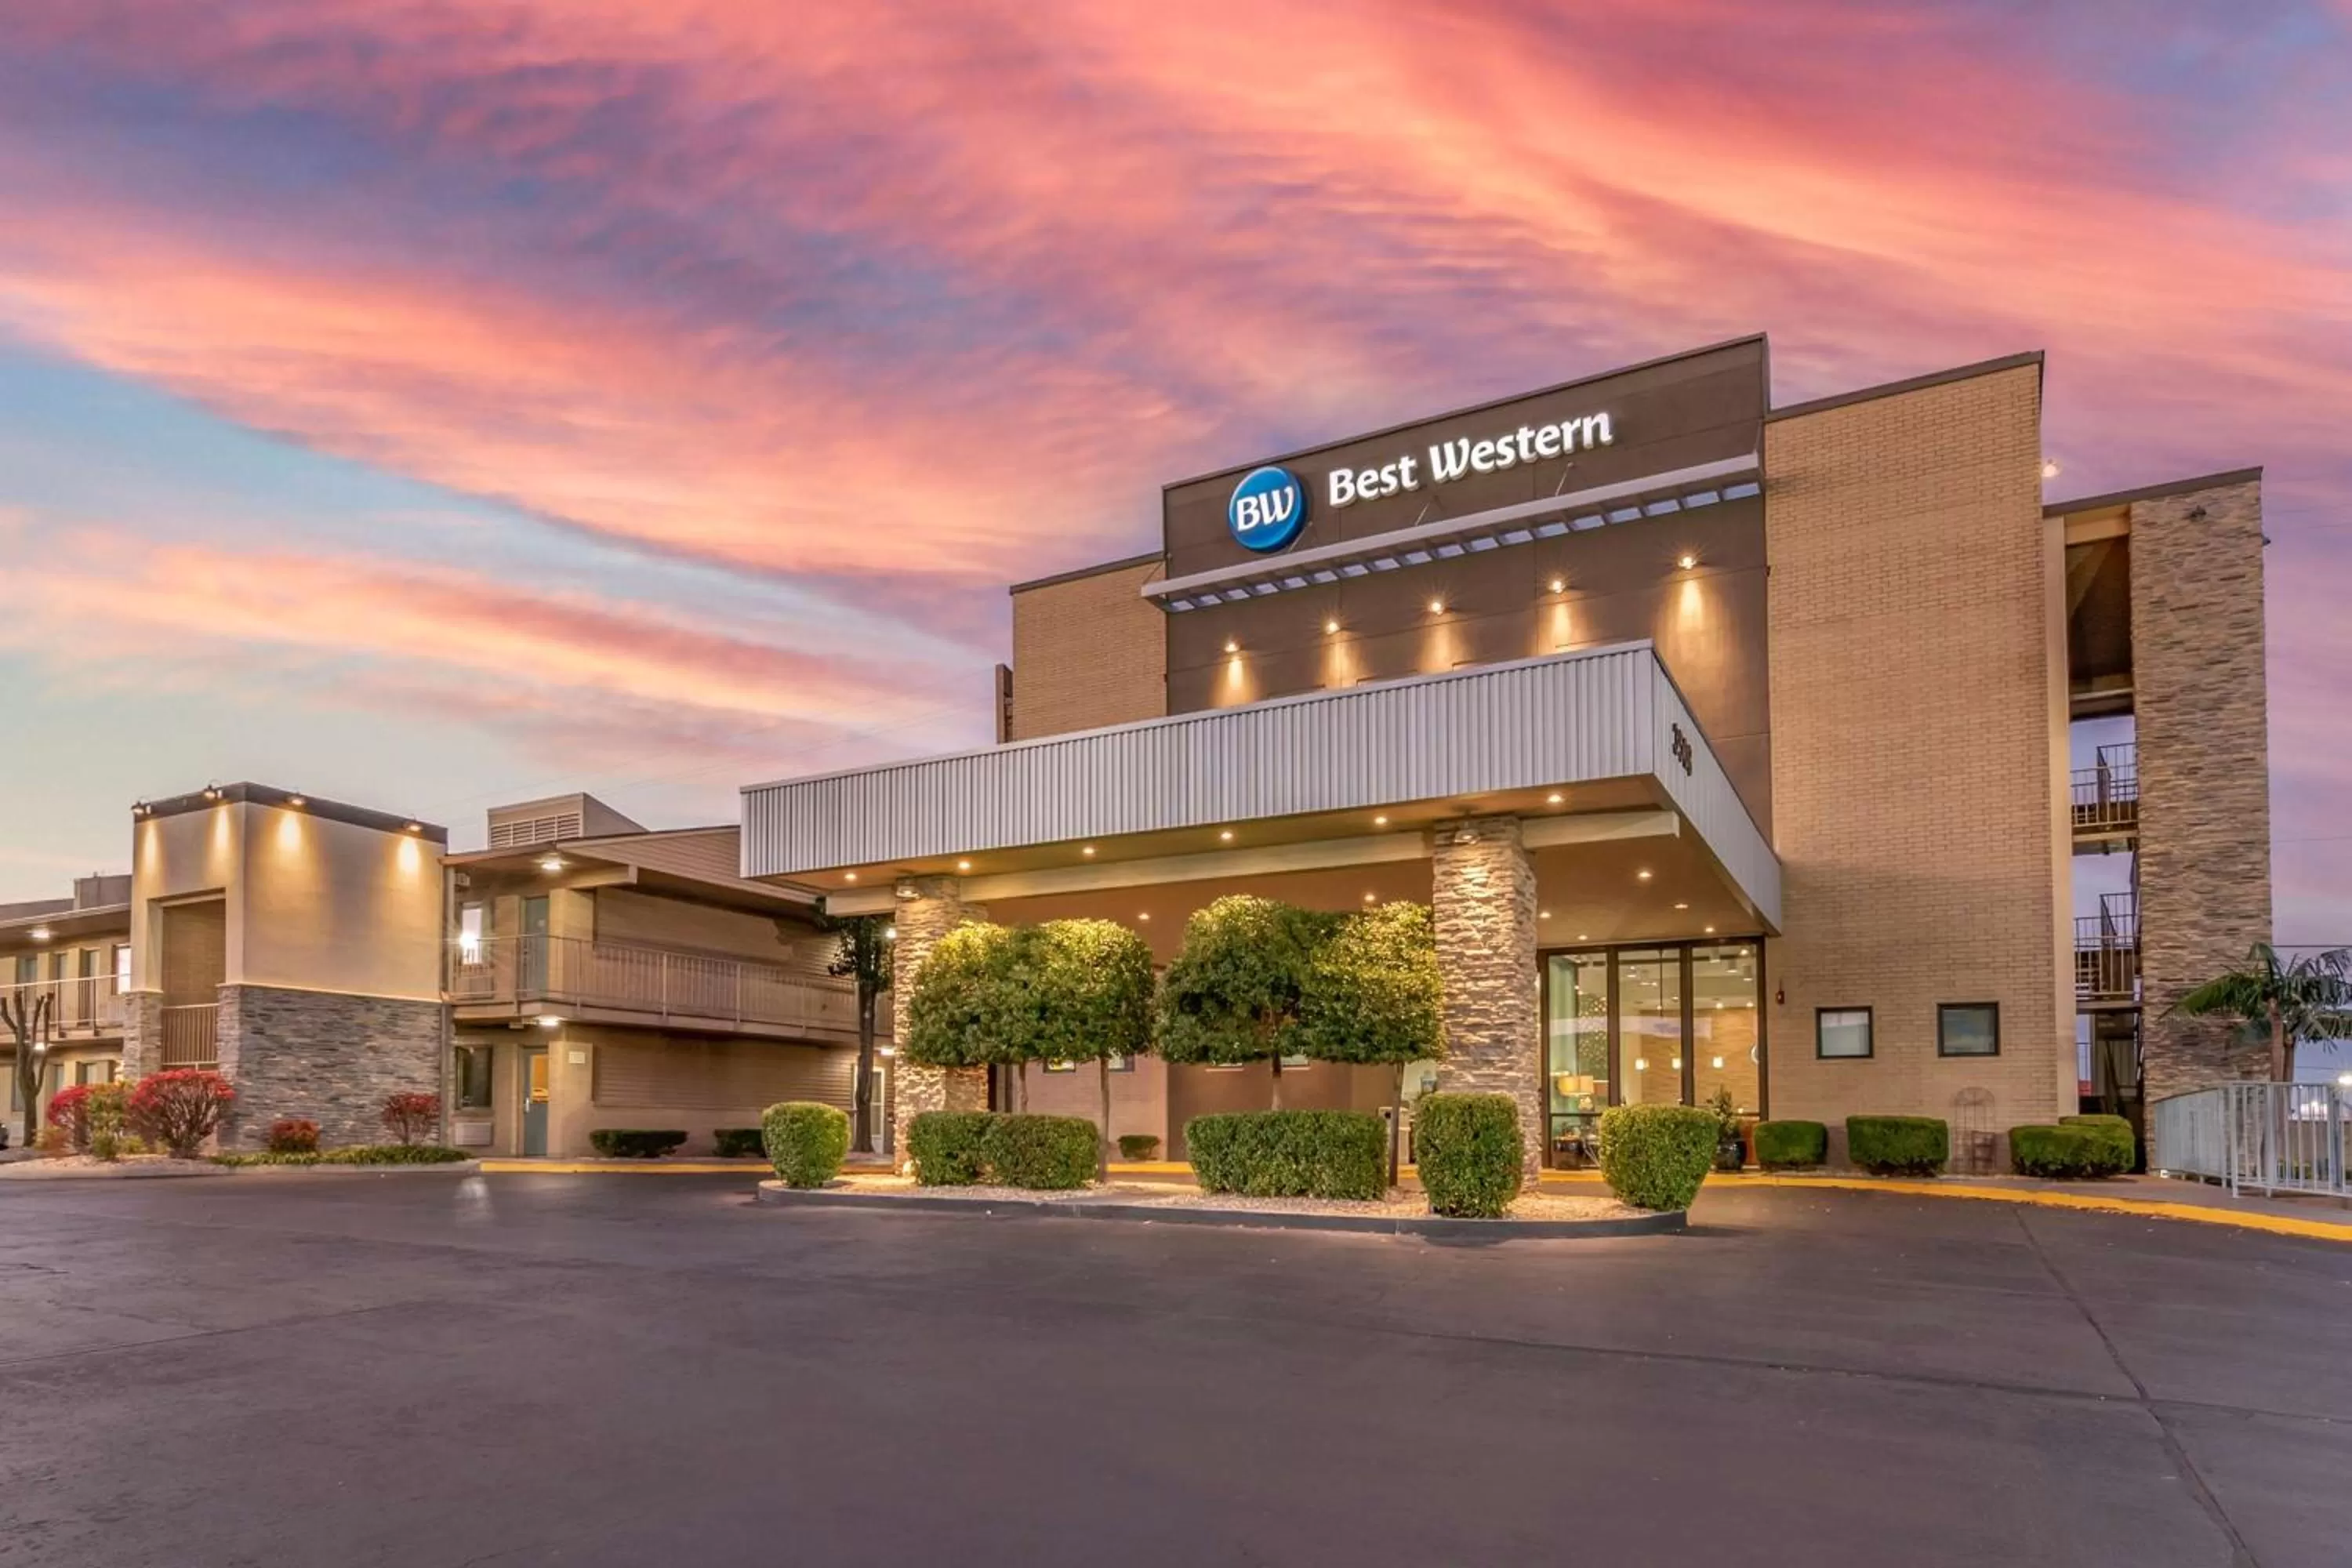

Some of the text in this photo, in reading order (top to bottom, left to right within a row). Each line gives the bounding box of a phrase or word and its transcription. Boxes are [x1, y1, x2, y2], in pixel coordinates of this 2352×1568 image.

[1329, 412, 1613, 506] Best Western
[1237, 485, 1294, 532] BW
